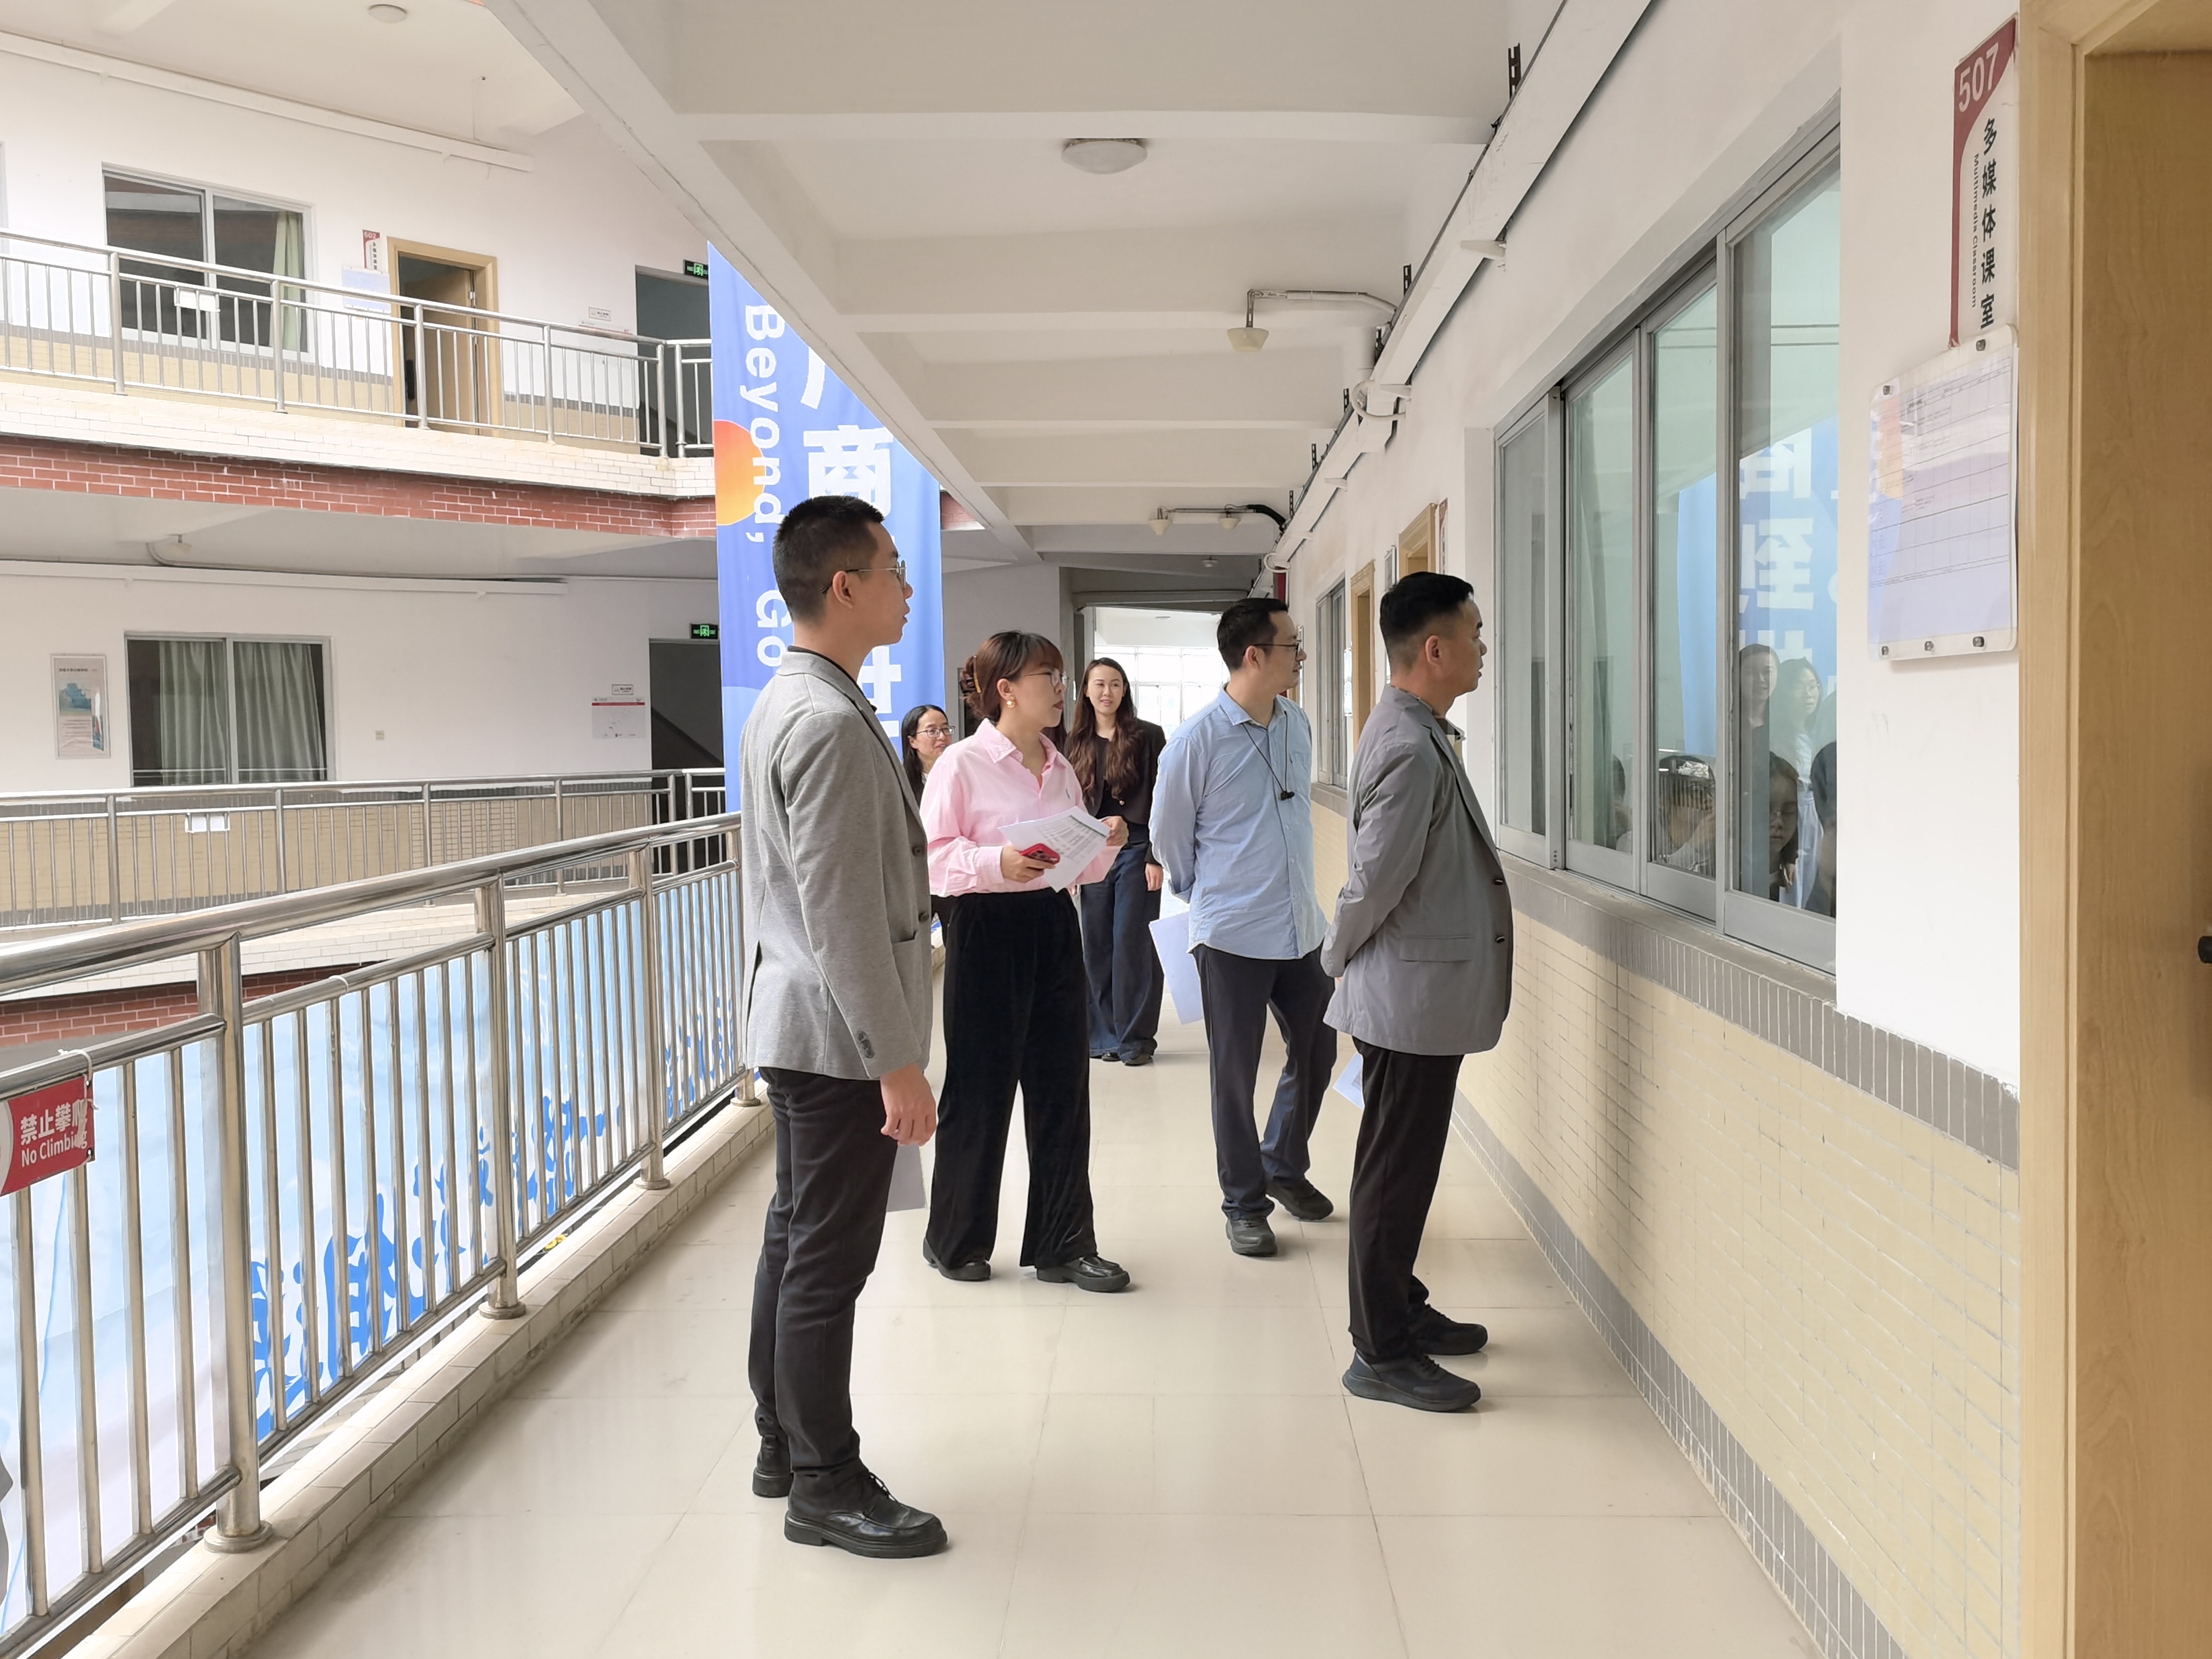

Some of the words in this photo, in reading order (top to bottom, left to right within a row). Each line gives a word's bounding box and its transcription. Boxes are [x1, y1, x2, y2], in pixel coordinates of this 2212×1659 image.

[1958, 43, 1999, 112] 507
[1972, 152, 1980, 233] Multimedia
[1980, 118, 1998, 329] 多媒体课室
[364, 231, 376, 239] 602
[1971, 235, 1979, 309] Classroom
[740, 304, 786, 542] Beyond,
[756, 589, 793, 667] Go
[22, 1149, 37, 1167] No
[39, 1130, 87, 1160] Climbig
